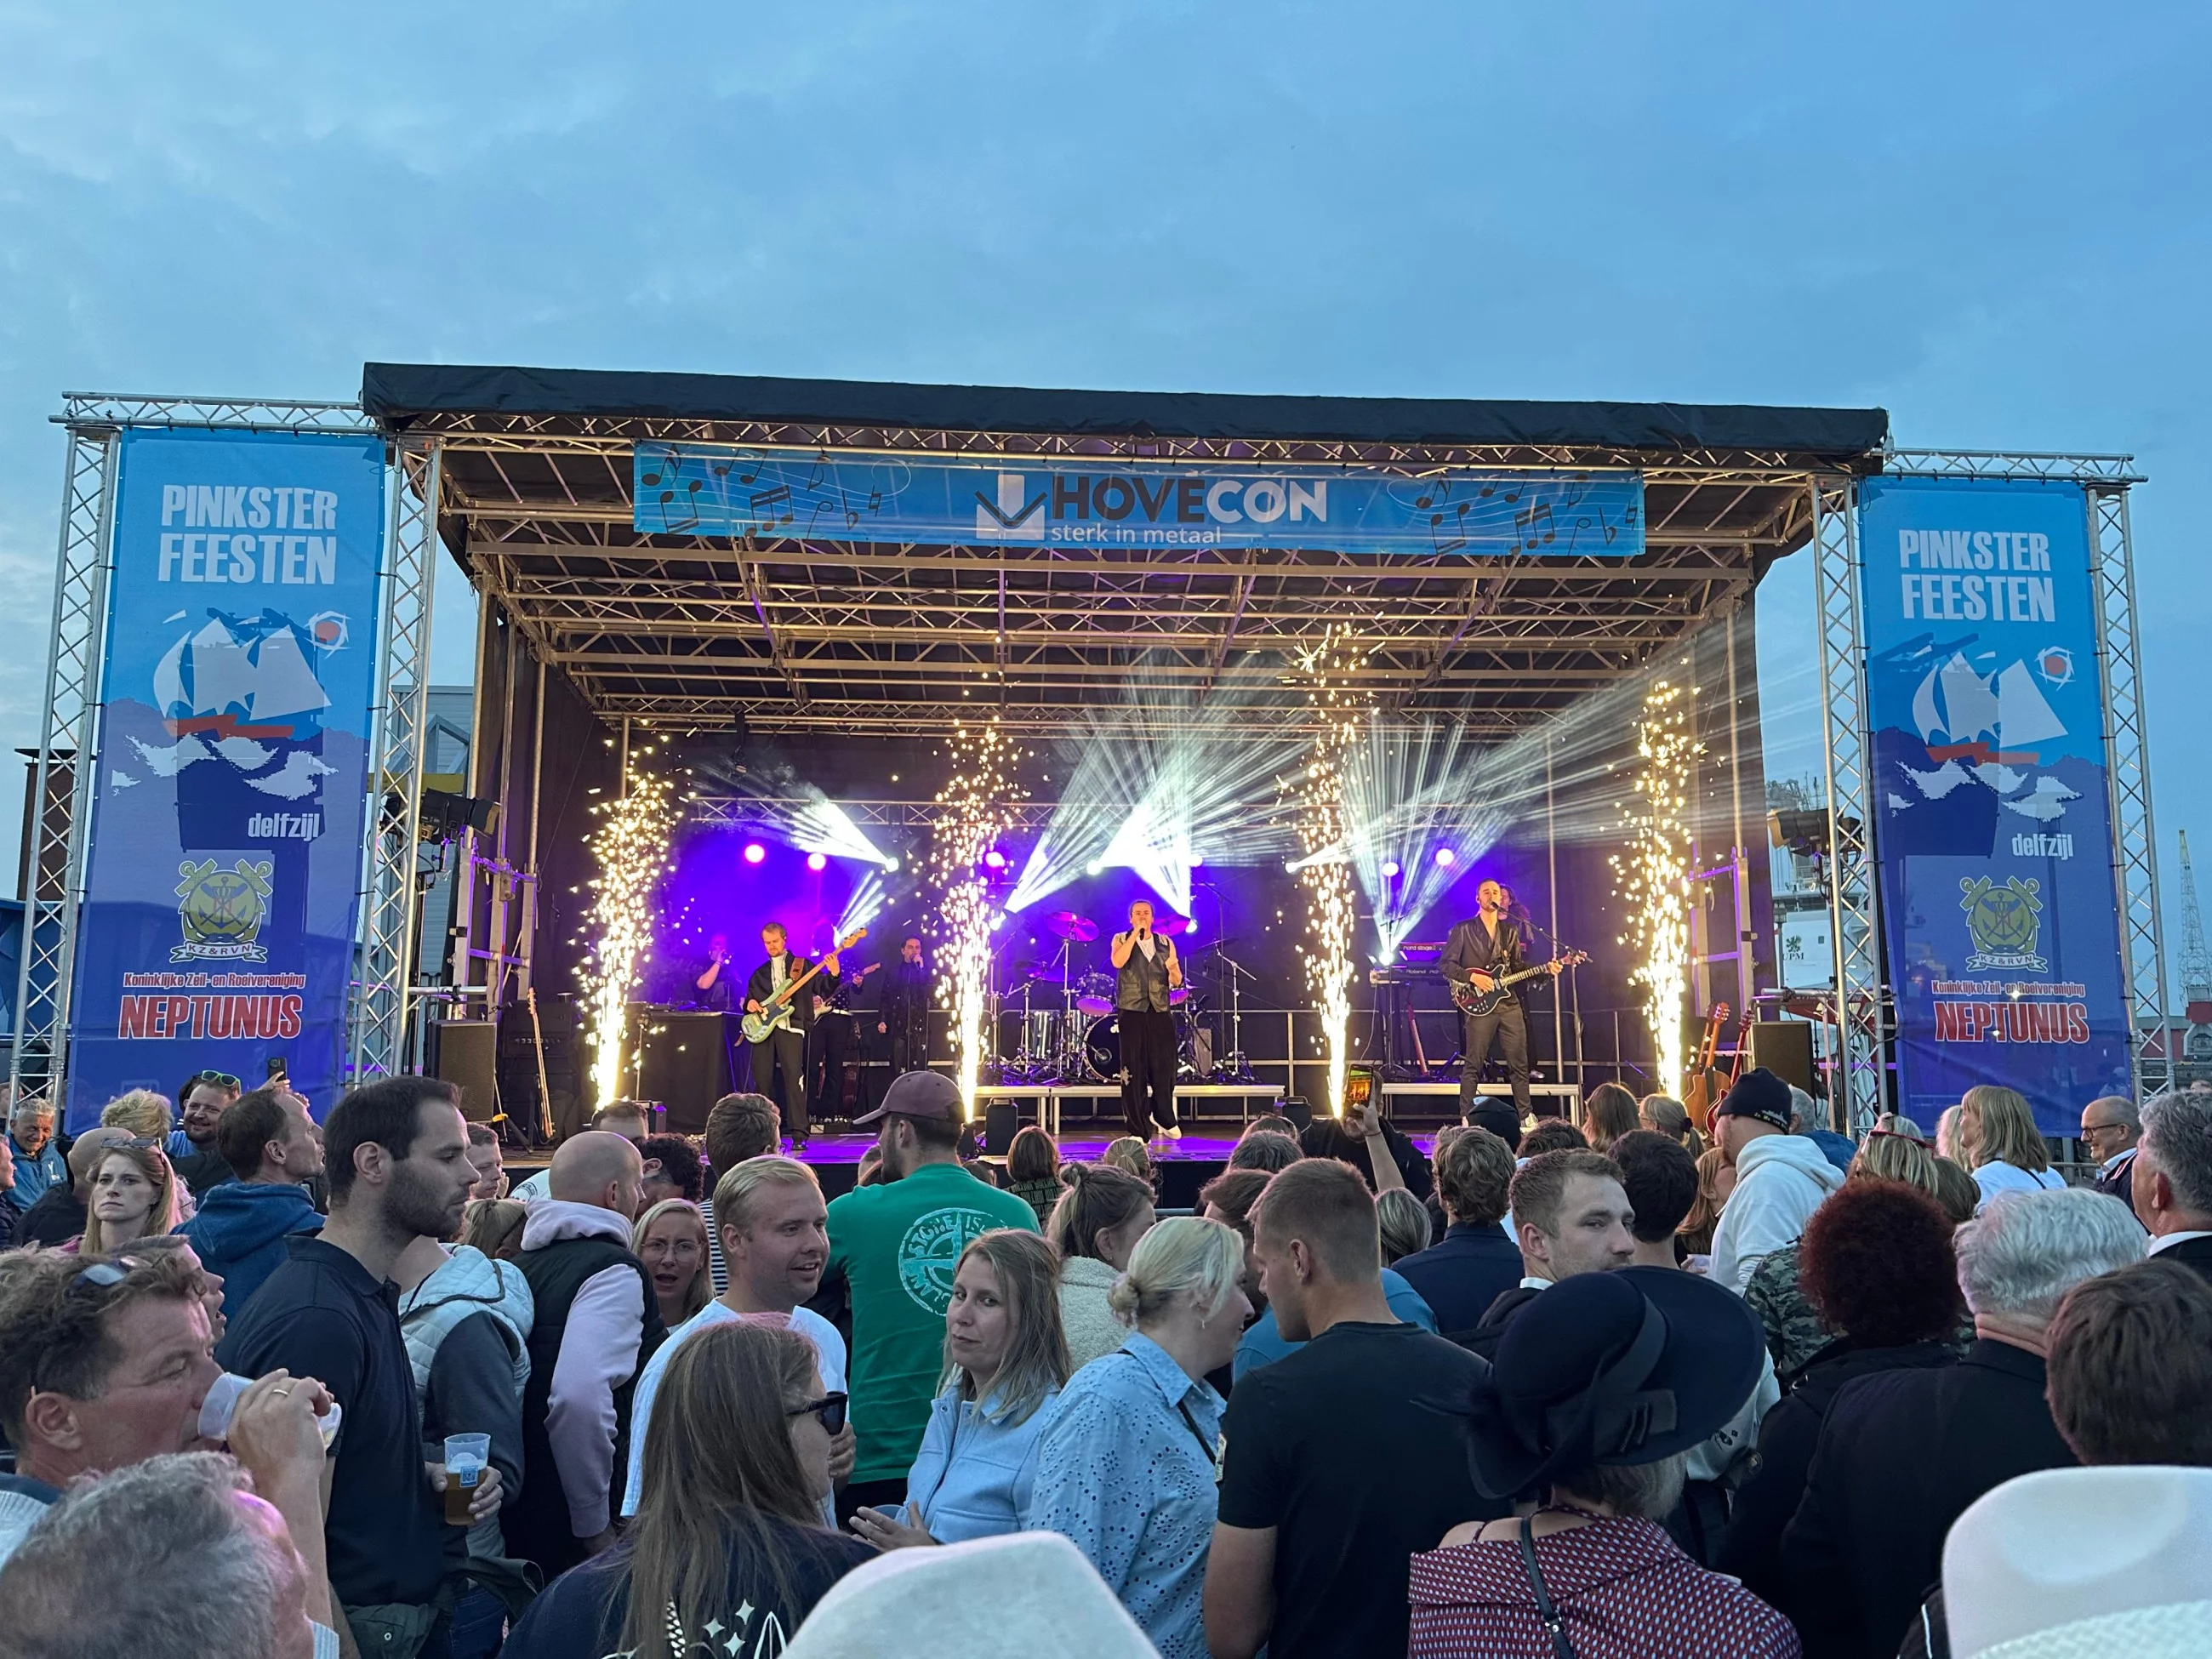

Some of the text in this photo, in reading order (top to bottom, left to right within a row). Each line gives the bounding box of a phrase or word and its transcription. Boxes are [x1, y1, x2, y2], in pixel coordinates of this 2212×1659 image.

[161, 484, 339, 530] PINKSTER
[1052, 476, 1327, 523] HOVECON
[1052, 522, 1221, 544] sterk in metaal
[1898, 529, 2051, 572] PINKSTER
[157, 533, 337, 584] FEESTEN
[1901, 573, 2055, 622] FEESTEN
[248, 812, 320, 842] delfzijl
[2011, 833, 2073, 861] delfzijl
[123, 972, 306, 989] Koninklijke Zeil- en Roeivereniging
[1931, 980, 1982, 997] Koninklijke
[1983, 981, 2005, 995] Zeil-
[2017, 982, 2086, 998] Roeivereniging
[118, 995, 303, 1040] NEPTUNUS
[1934, 1001, 2089, 1044] NEPTUNUS
